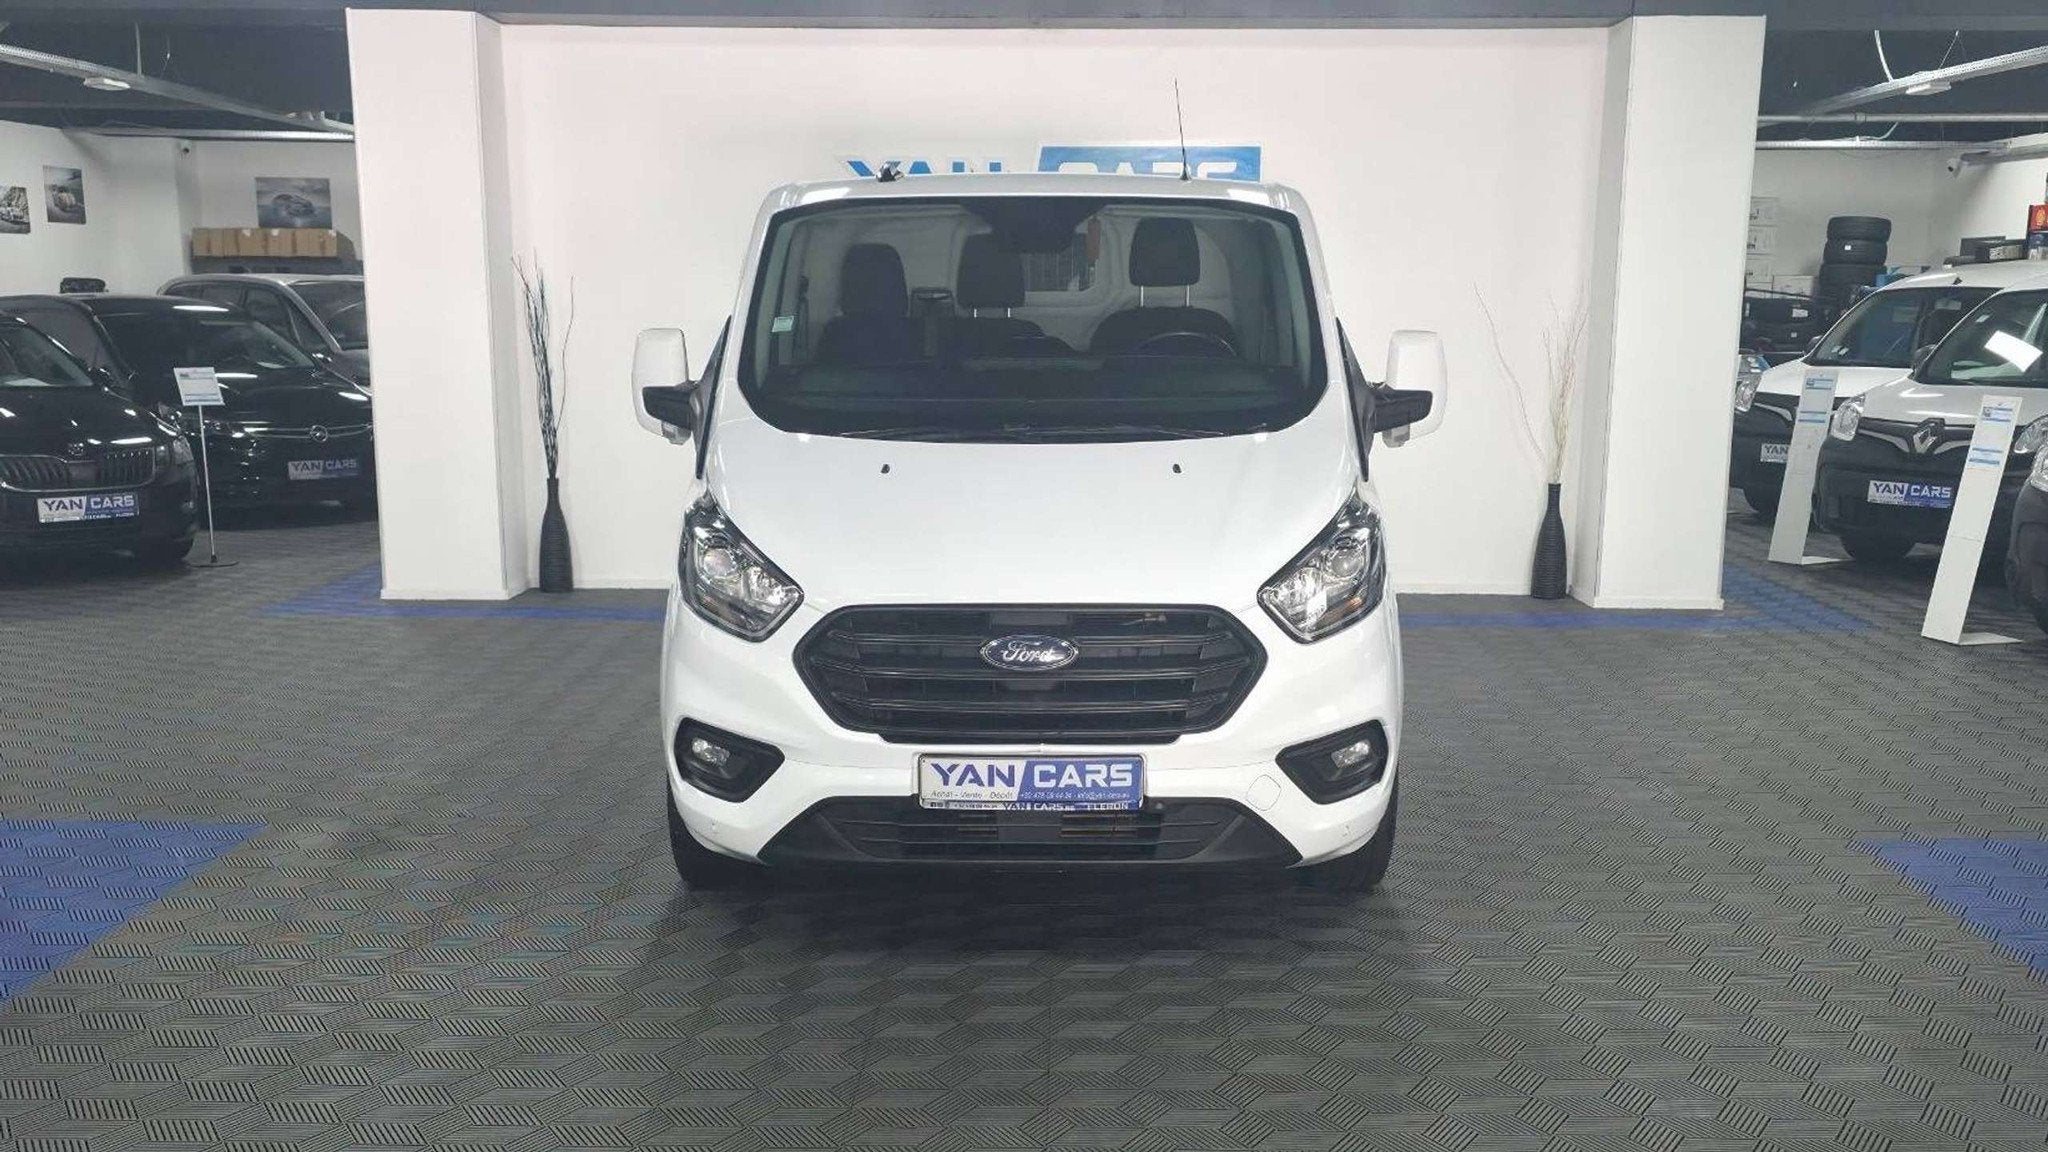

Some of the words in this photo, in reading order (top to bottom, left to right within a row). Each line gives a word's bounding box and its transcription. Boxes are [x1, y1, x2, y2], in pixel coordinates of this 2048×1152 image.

[291, 461, 321, 471] YAN
[1873, 482, 1905, 494] YAN
[1910, 484, 1952, 498] CARS
[43, 499, 83, 511] YAN
[90, 495, 135, 508] CARS
[1001, 641, 1065, 662] Ford
[931, 763, 1015, 788] YAN
[1033, 763, 1133, 788] CARS
